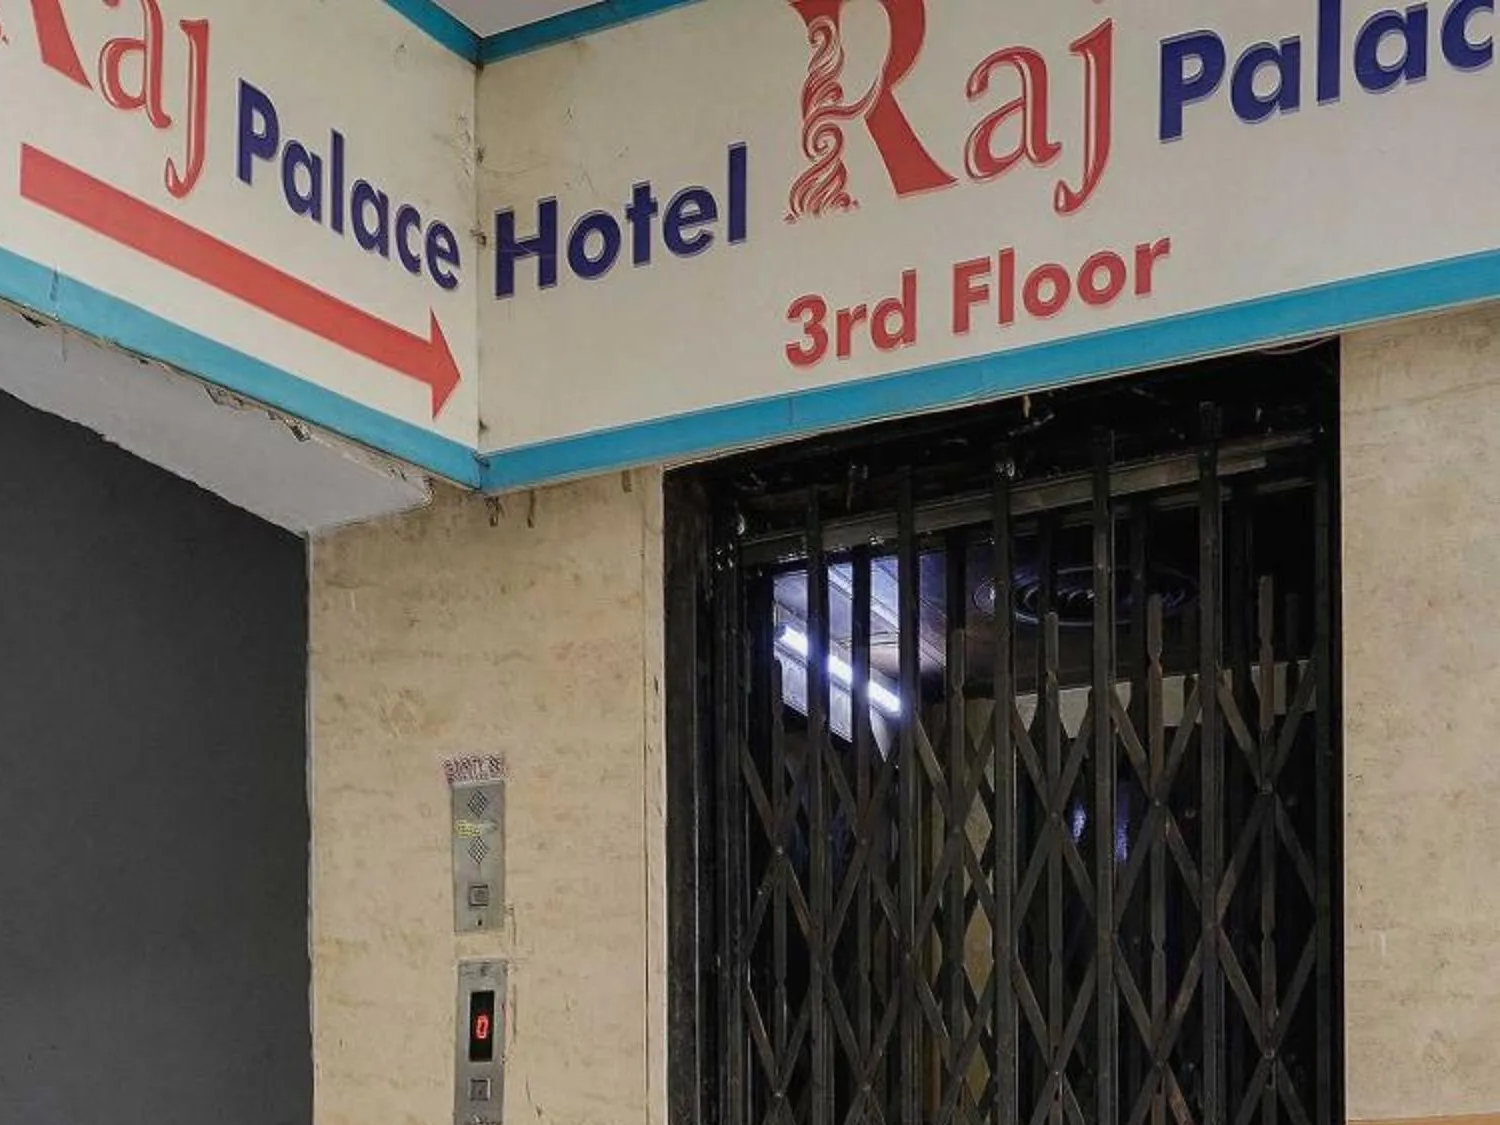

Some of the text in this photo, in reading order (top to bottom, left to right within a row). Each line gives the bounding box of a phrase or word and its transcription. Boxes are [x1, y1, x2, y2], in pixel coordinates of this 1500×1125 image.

[235, 77, 461, 290] Palace
[495, 141, 748, 299] Hotel
[784, 0, 1114, 224] Raj
[785, 236, 1171, 368] 3rd Floor
